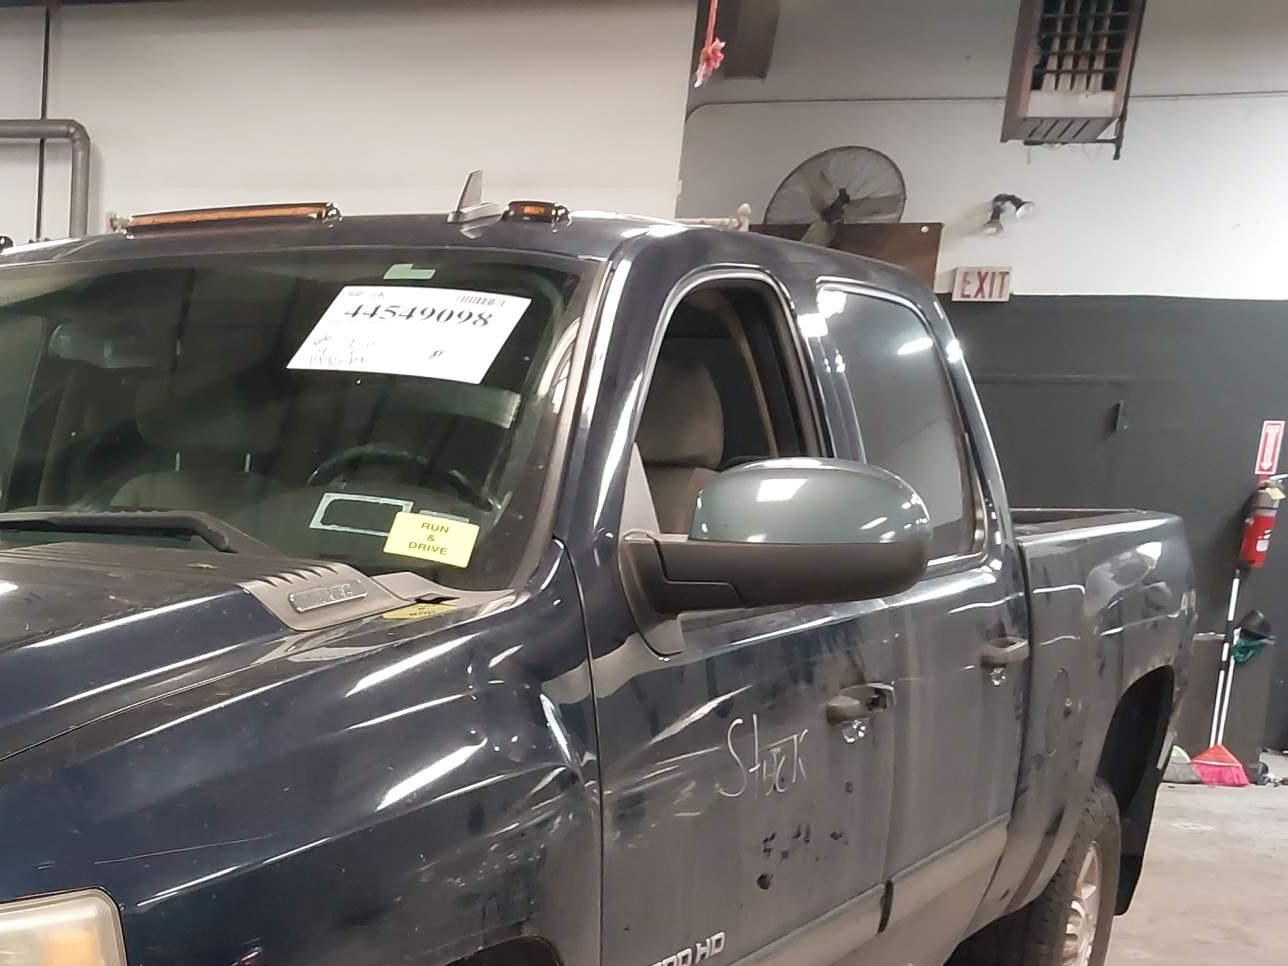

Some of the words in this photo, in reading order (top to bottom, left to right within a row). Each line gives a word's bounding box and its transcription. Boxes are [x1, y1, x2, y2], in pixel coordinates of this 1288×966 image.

[960, 270, 1010, 299] EXIT
[343, 303, 494, 327] 44549098
[420, 522, 450, 534] RUN
[426, 534, 436, 542] &
[408, 541, 448, 556] DRIVE
[695, 931, 726, 965] HD
